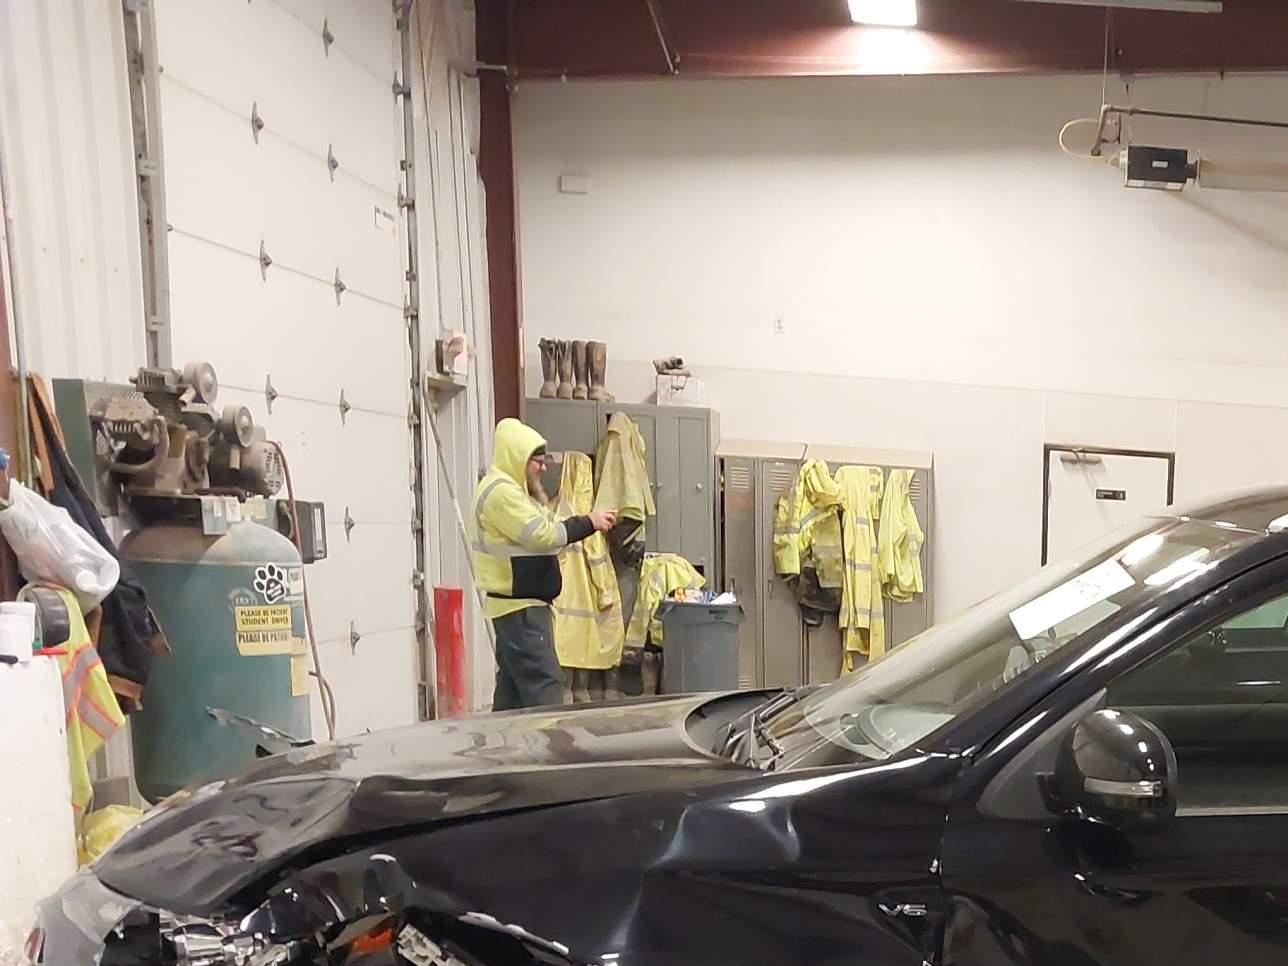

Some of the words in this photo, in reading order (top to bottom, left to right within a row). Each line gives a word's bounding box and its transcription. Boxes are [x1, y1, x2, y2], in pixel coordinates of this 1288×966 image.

[240, 609, 261, 617] PLEASE
[241, 617, 269, 626] STUDENT
[238, 633, 260, 643] PLEASE
